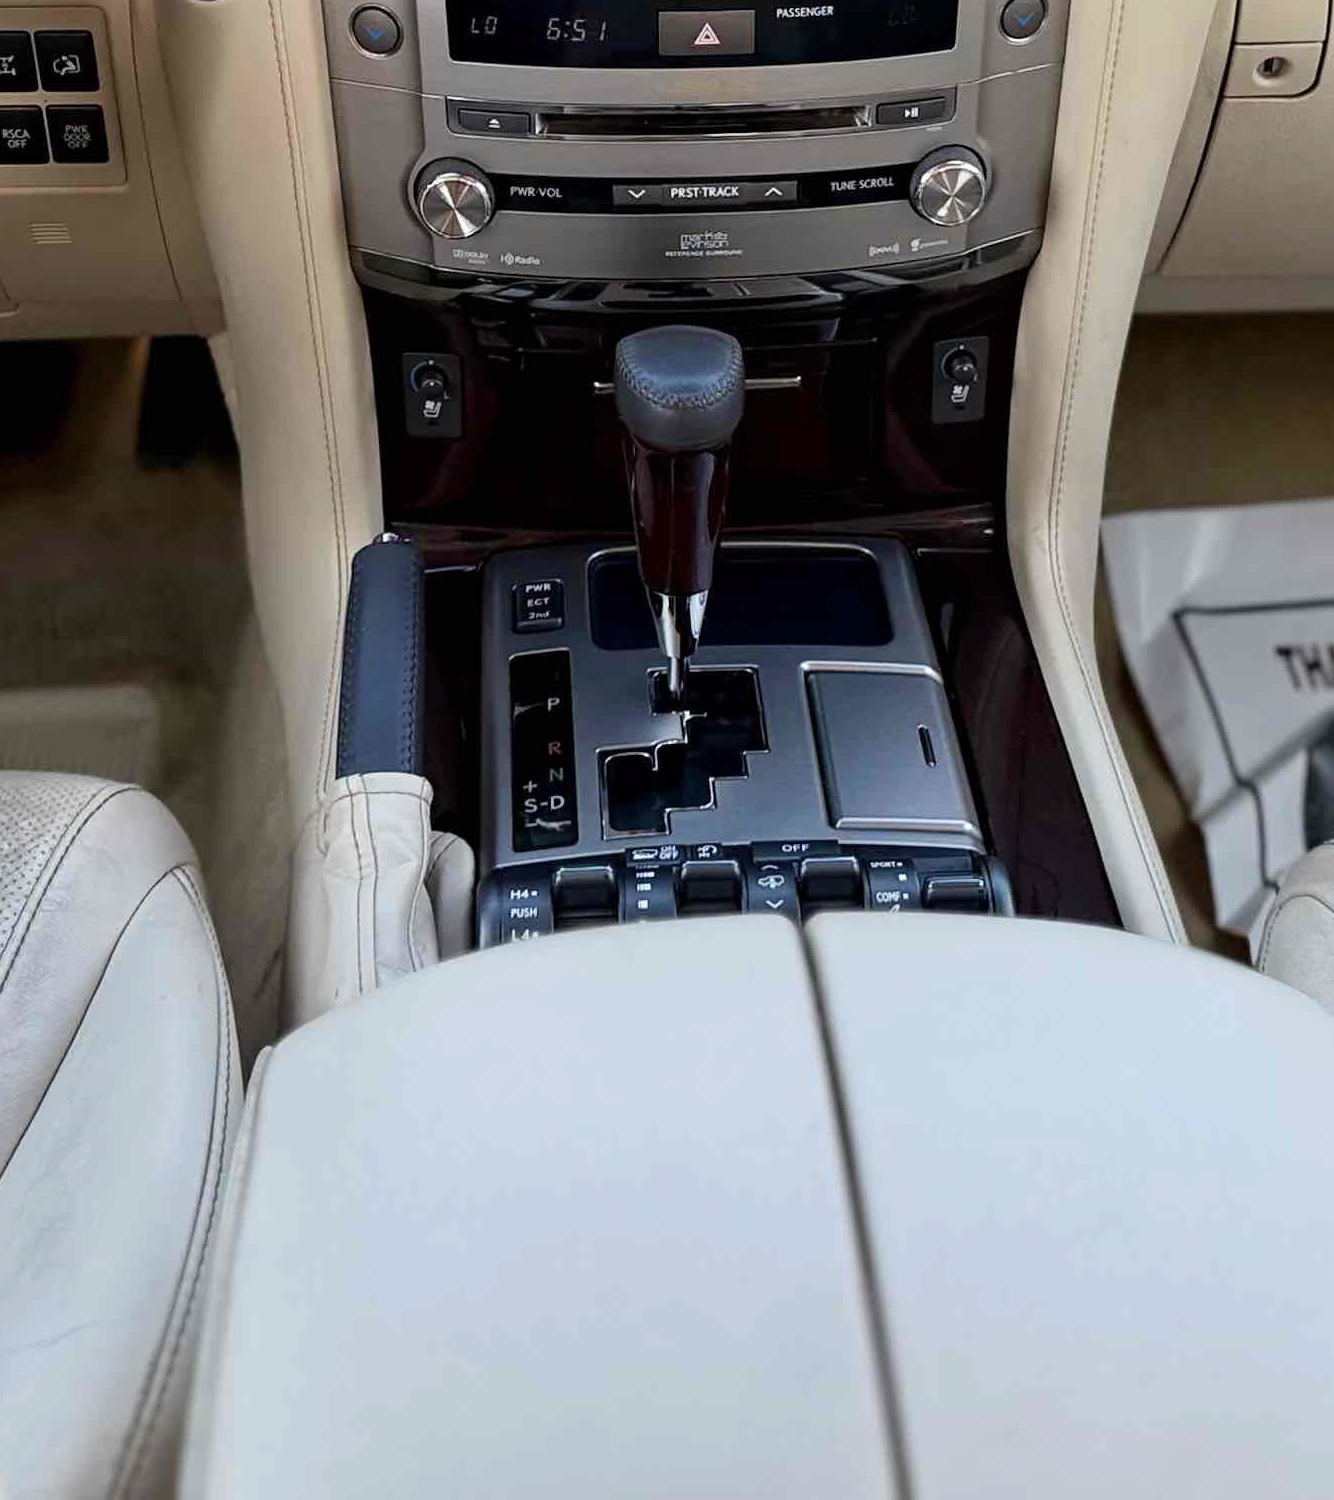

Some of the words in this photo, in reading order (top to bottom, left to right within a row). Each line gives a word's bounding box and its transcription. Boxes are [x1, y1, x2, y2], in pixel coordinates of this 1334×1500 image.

[775, 5, 835, 19] PASSENGER
[546, 17, 607, 43] 6:51
[2, 128, 31, 140] RSCA
[7, 139, 28, 149] OFF
[525, 582, 552, 593] PWR
[527, 597, 550, 608] ECT
[547, 697, 561, 712] P
[548, 741, 561, 756] R
[548, 767, 564, 782] N
[781, 843, 811, 853] OFF
[510, 889, 529, 900] H4
[510, 907, 538, 919] PUSH
